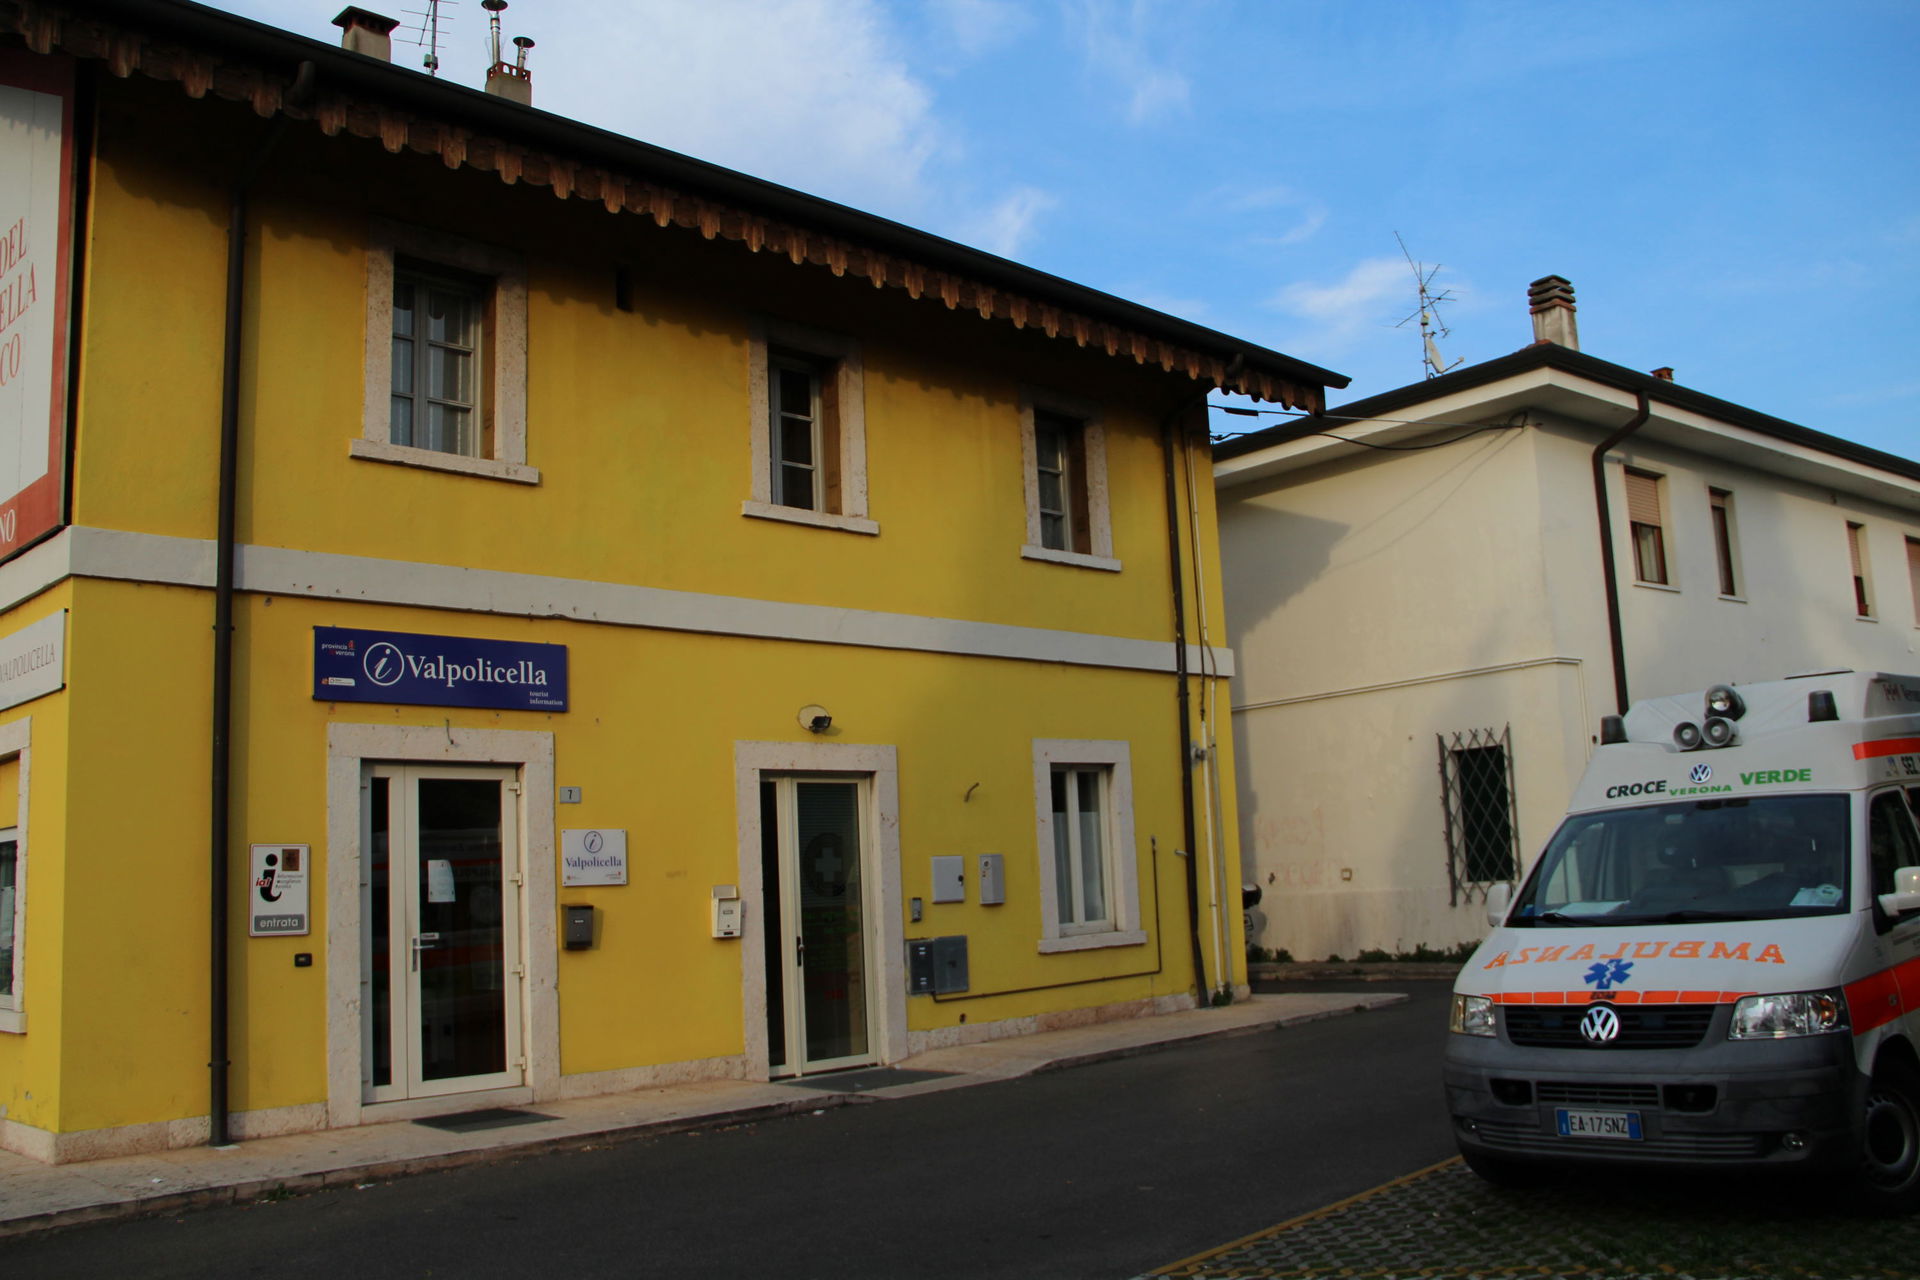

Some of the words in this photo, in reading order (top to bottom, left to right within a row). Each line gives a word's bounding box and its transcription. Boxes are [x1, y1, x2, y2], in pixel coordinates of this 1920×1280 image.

[406, 654, 548, 688] Valpolicella
[1739, 768, 1812, 786] VERDE
[567, 789, 573, 800] 7
[1606, 780, 1667, 799] CROCE
[1669, 784, 1733, 796] VERONA
[565, 856, 622, 870] Valpolicella
[260, 918, 299, 928] entrata
